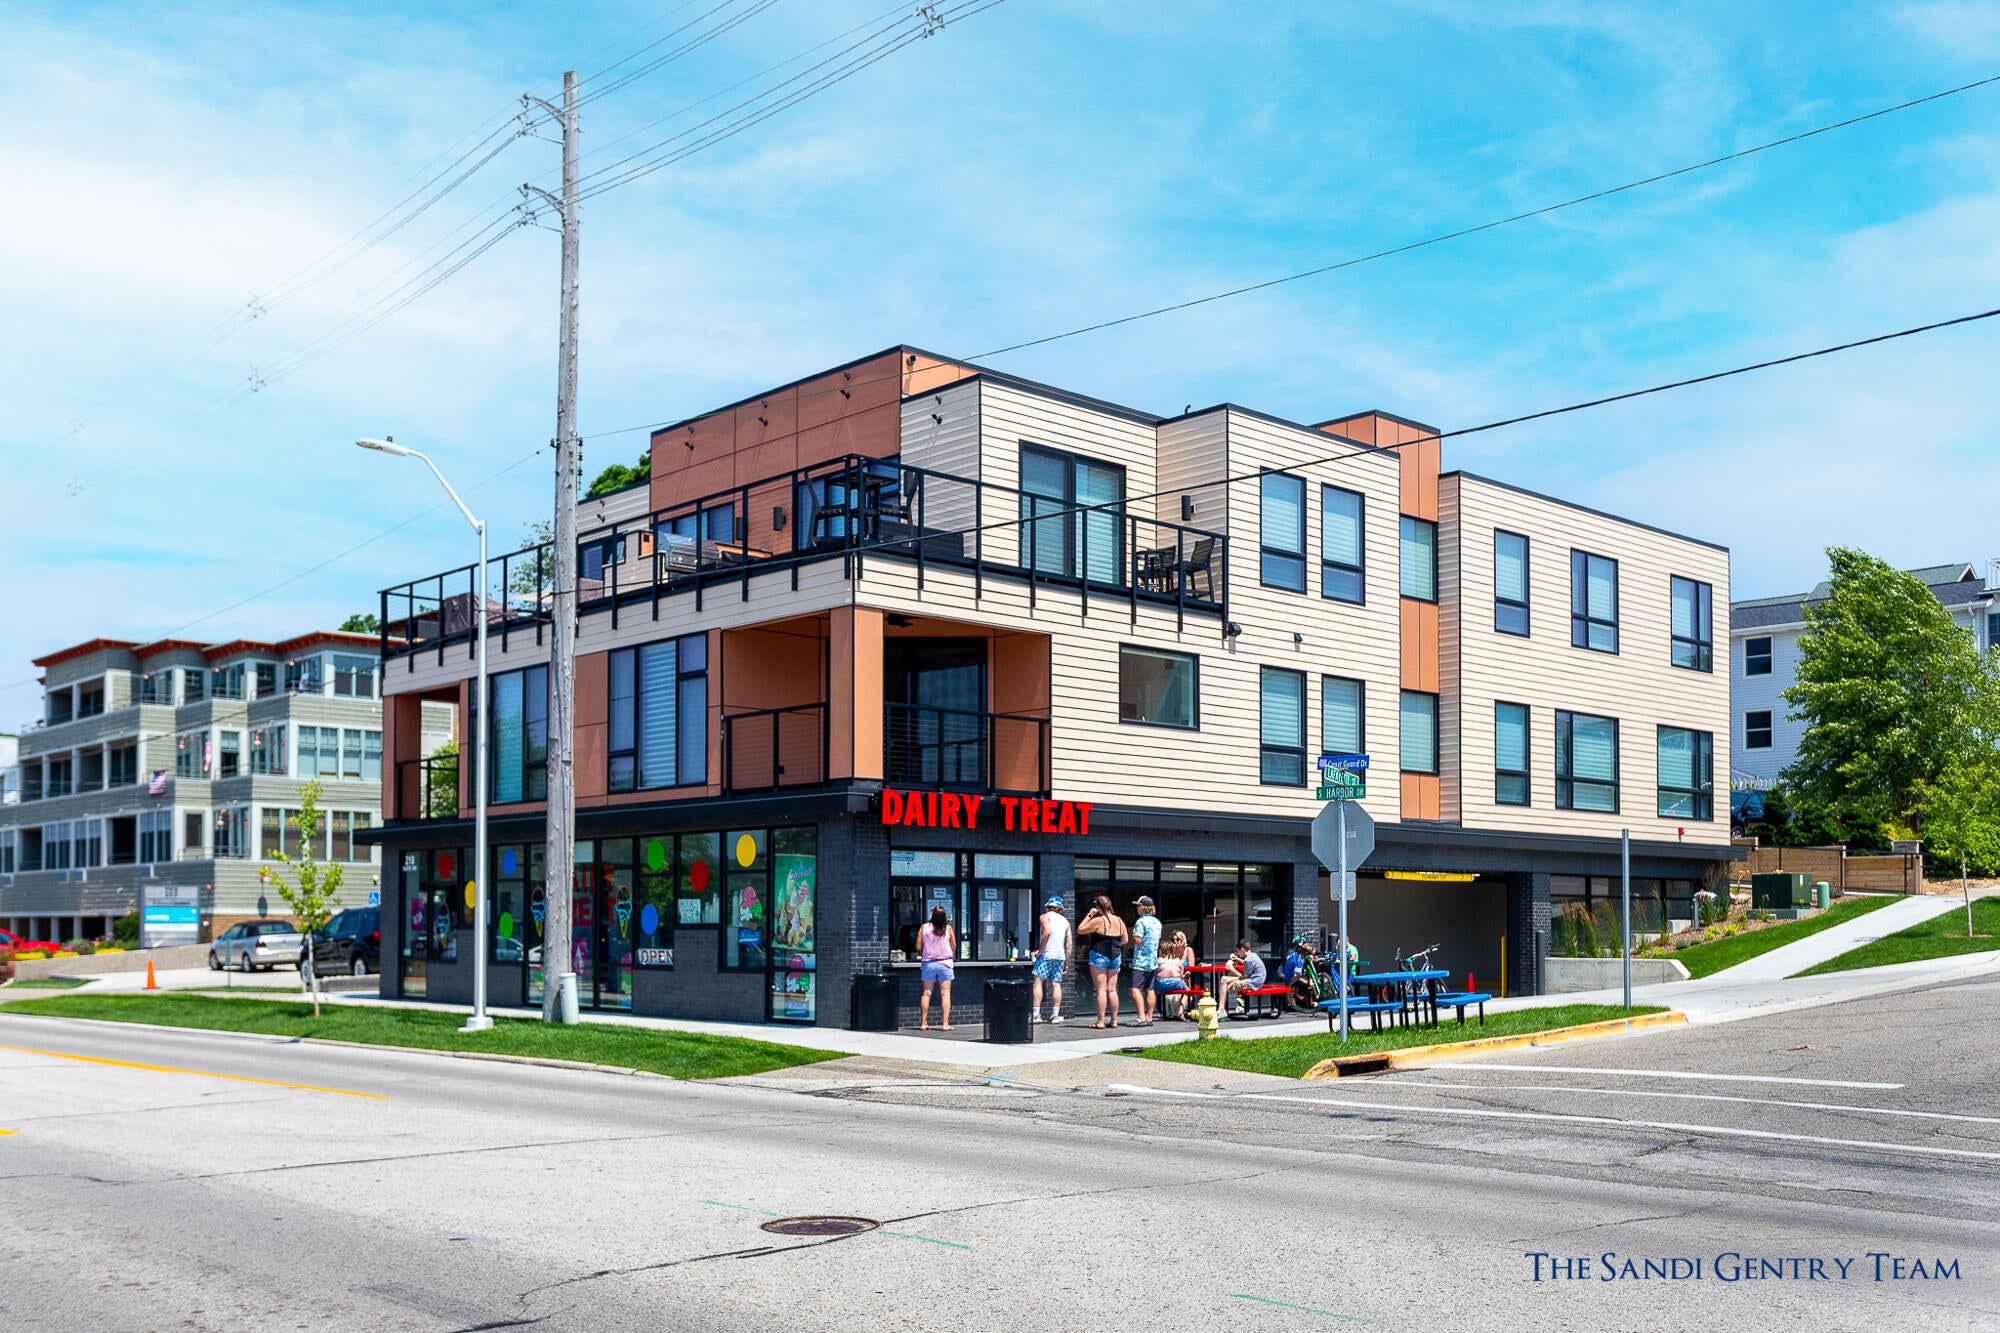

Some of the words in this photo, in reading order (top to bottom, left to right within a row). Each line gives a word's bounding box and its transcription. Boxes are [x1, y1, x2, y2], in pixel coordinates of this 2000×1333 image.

[1343, 760, 1360, 768] Guard
[1318, 789, 1322, 798] S
[1326, 787, 1354, 799] HARBOR
[1356, 788, 1364, 796] DR
[882, 788, 983, 829] DAIRY
[1000, 796, 1094, 835] TREAT
[641, 949, 674, 963] OPEN
